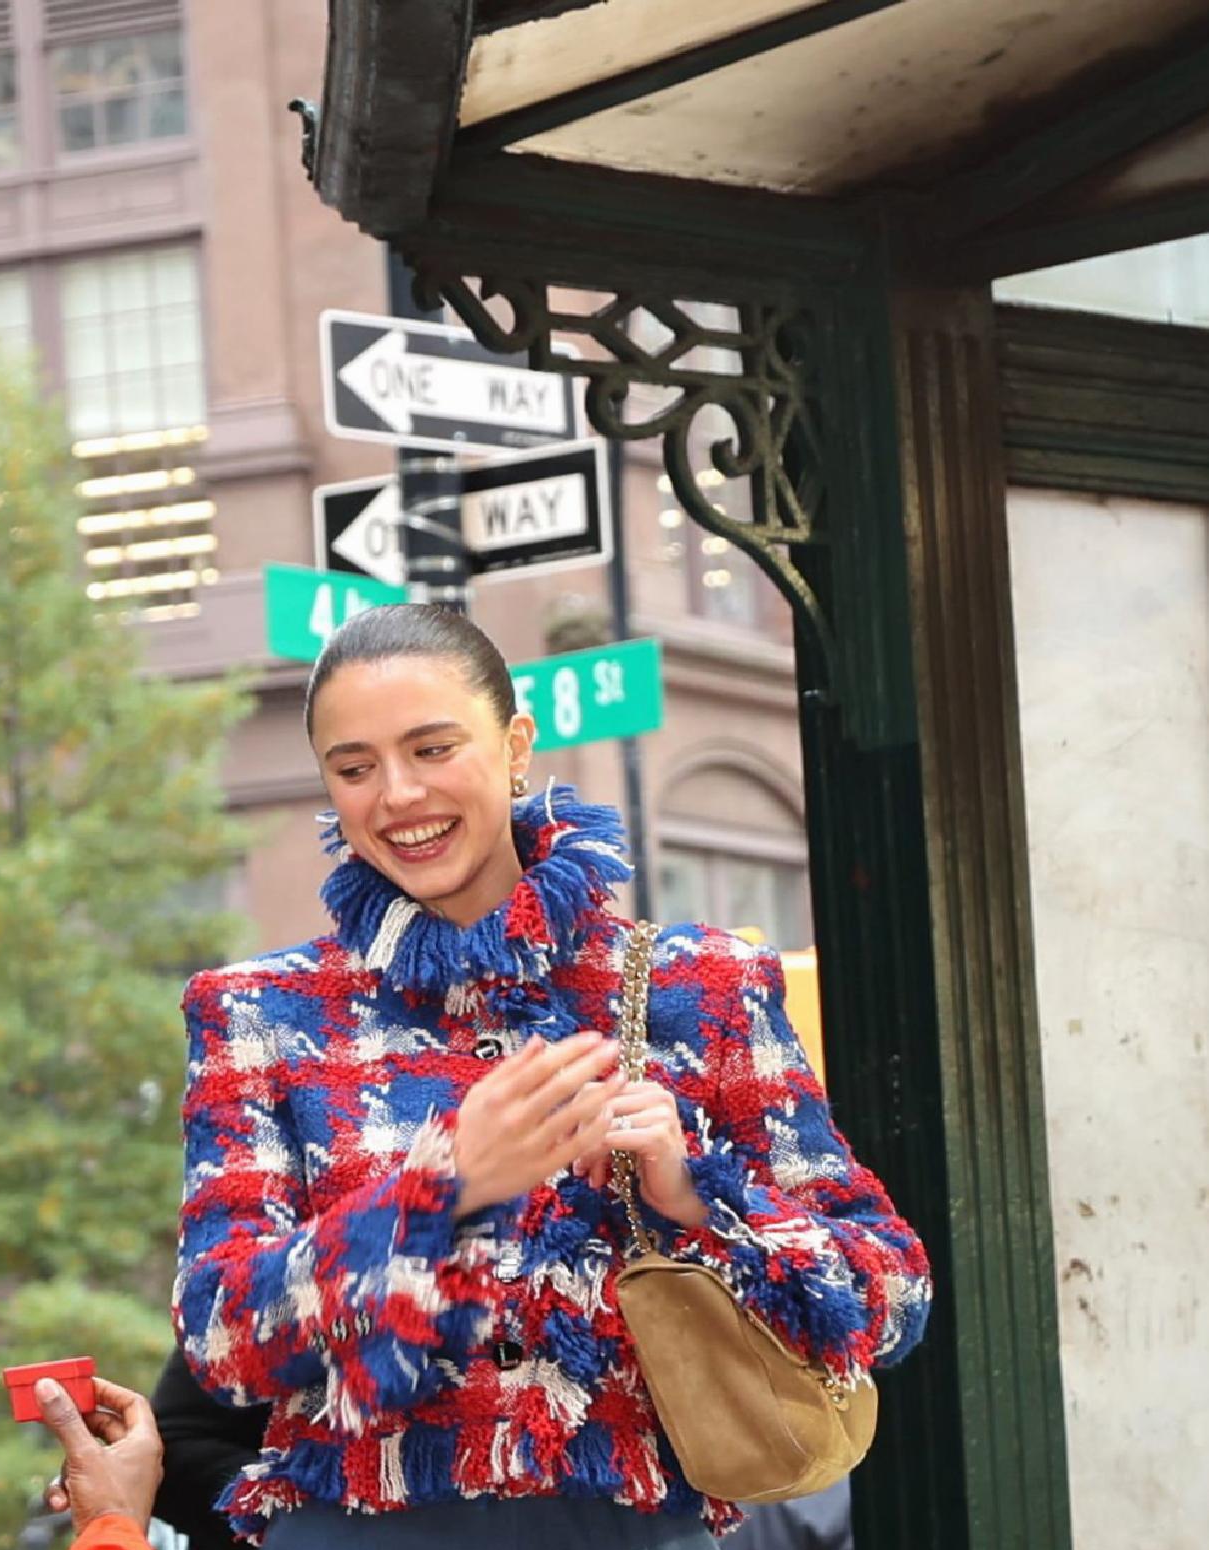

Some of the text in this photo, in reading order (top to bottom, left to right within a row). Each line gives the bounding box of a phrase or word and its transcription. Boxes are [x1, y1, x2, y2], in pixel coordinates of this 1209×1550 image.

[370, 357, 548, 418] ONE WAY
[481, 486, 564, 538] WAY
[309, 583, 338, 641] 4
[552, 666, 582, 739] 8
